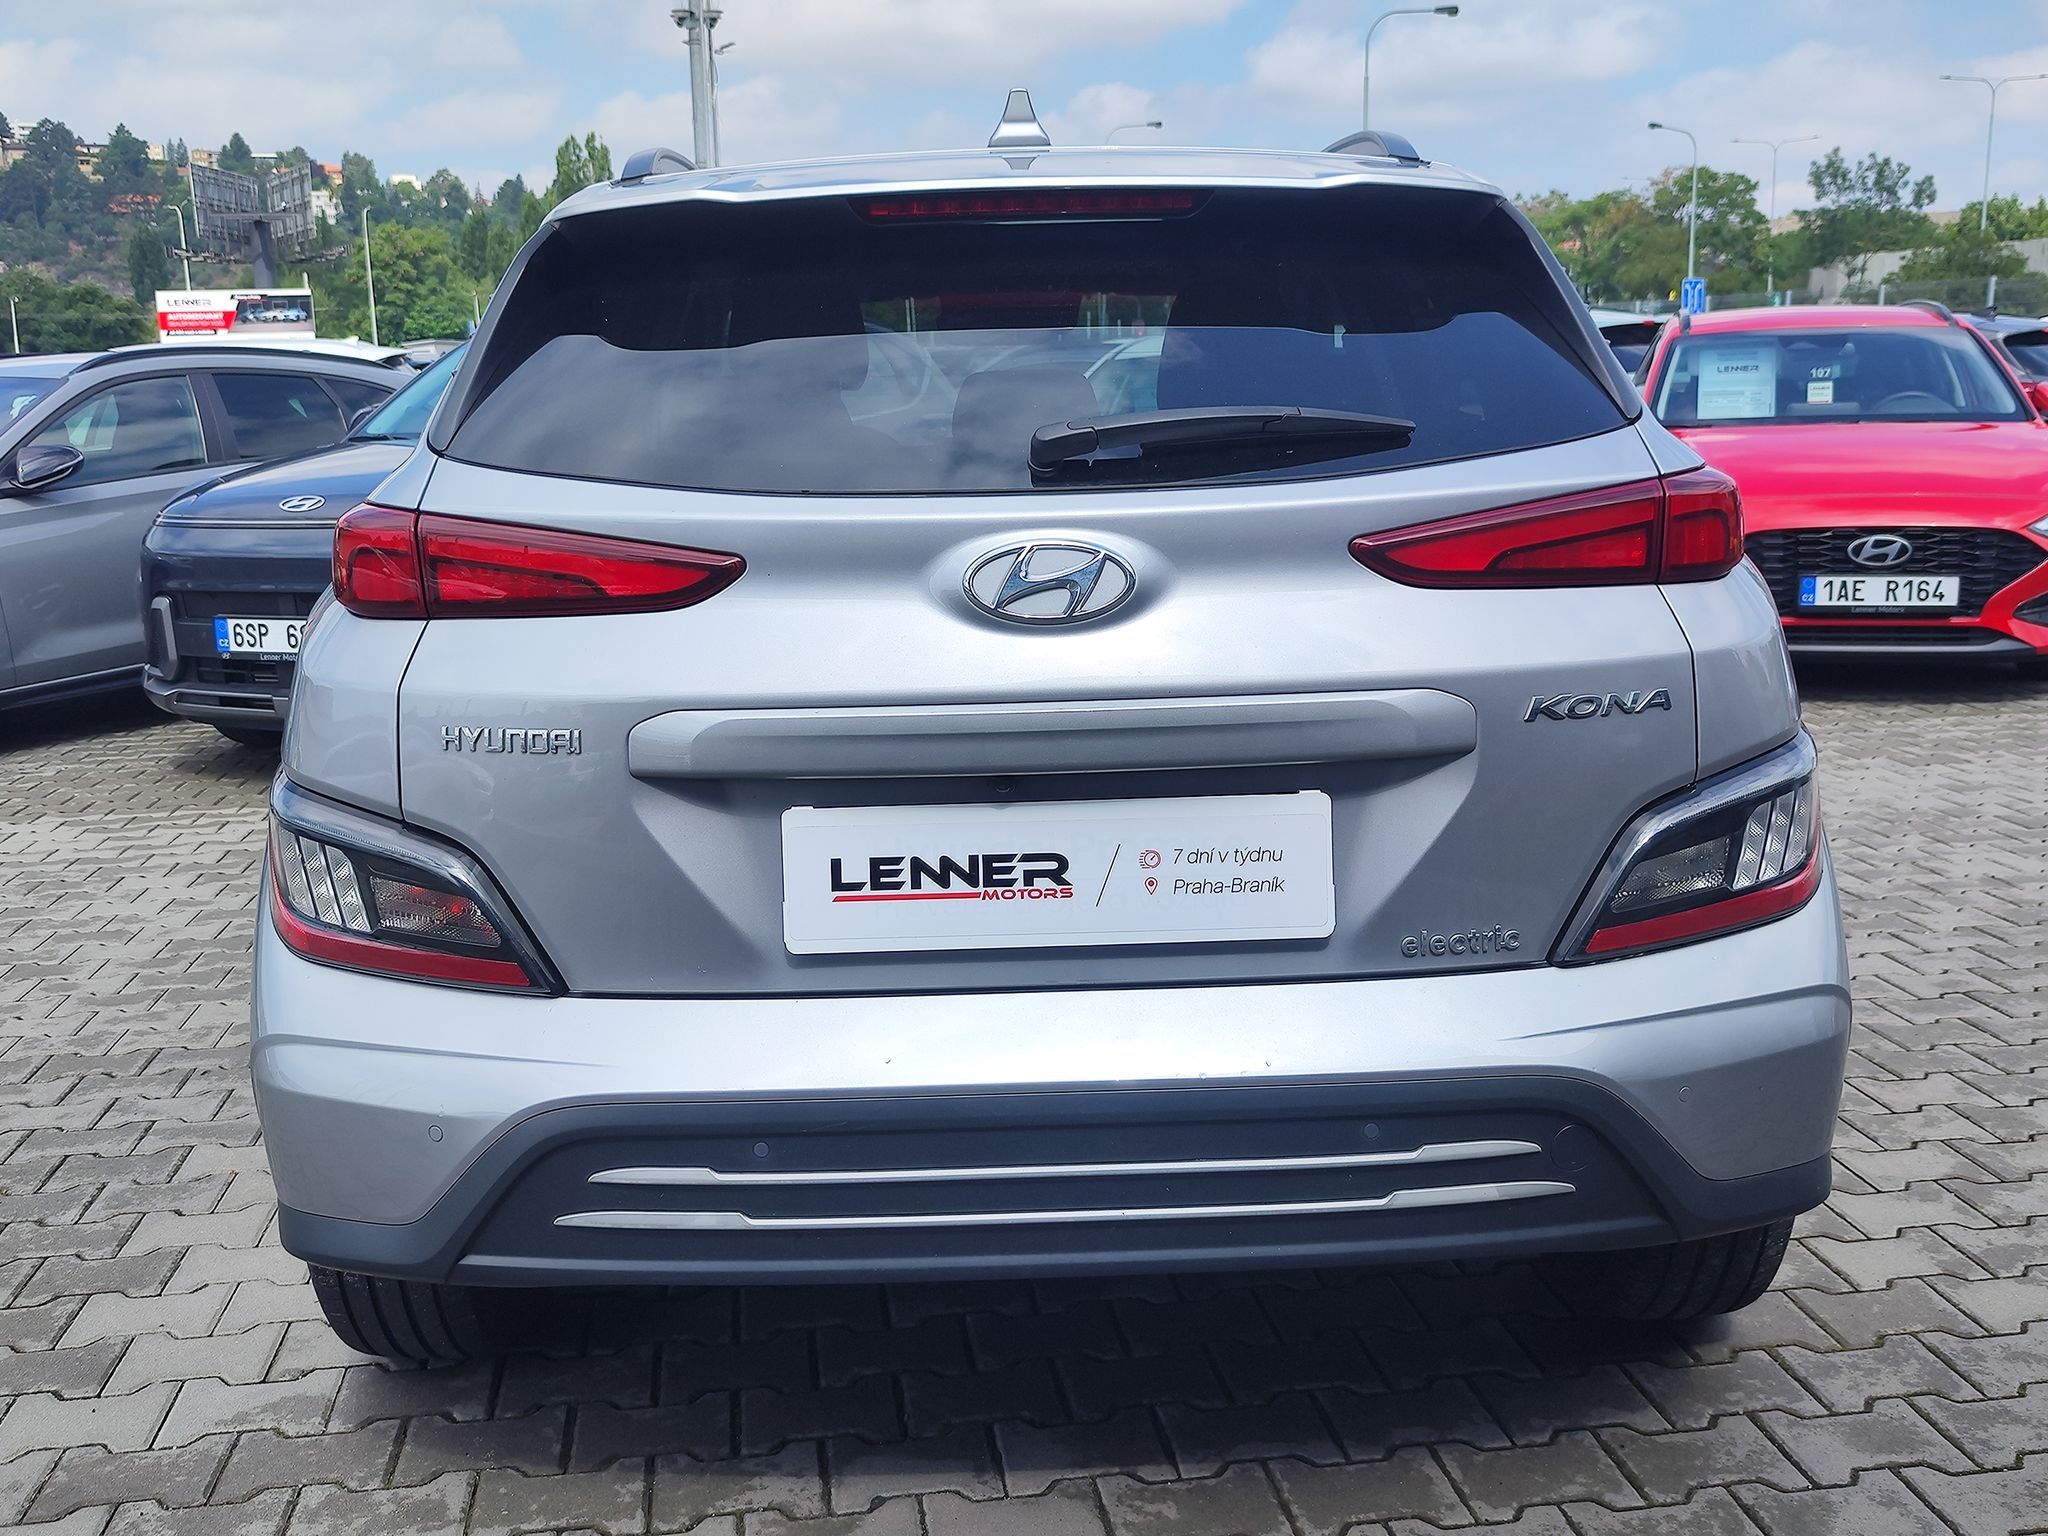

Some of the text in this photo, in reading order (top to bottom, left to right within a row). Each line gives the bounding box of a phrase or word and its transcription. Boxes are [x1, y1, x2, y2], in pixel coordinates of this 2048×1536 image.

[166, 299, 212, 307] LENNER
[1716, 365, 1760, 374] LENNER
[1809, 367, 1831, 379] 107
[1823, 580, 1945, 602] 1AE R164
[219, 638, 230, 648] CZ
[233, 623, 269, 649] 6SP
[260, 653, 281, 661] Lenner
[1523, 687, 1673, 723] KONA
[440, 724, 583, 755] HYUNDAI
[1173, 846, 1284, 867] 7 dní v týdnu
[830, 852, 1073, 892] LENNER
[981, 887, 1074, 901] MOTORS
[1173, 876, 1286, 896] Praha-Braník
[1401, 923, 1521, 959] electric
